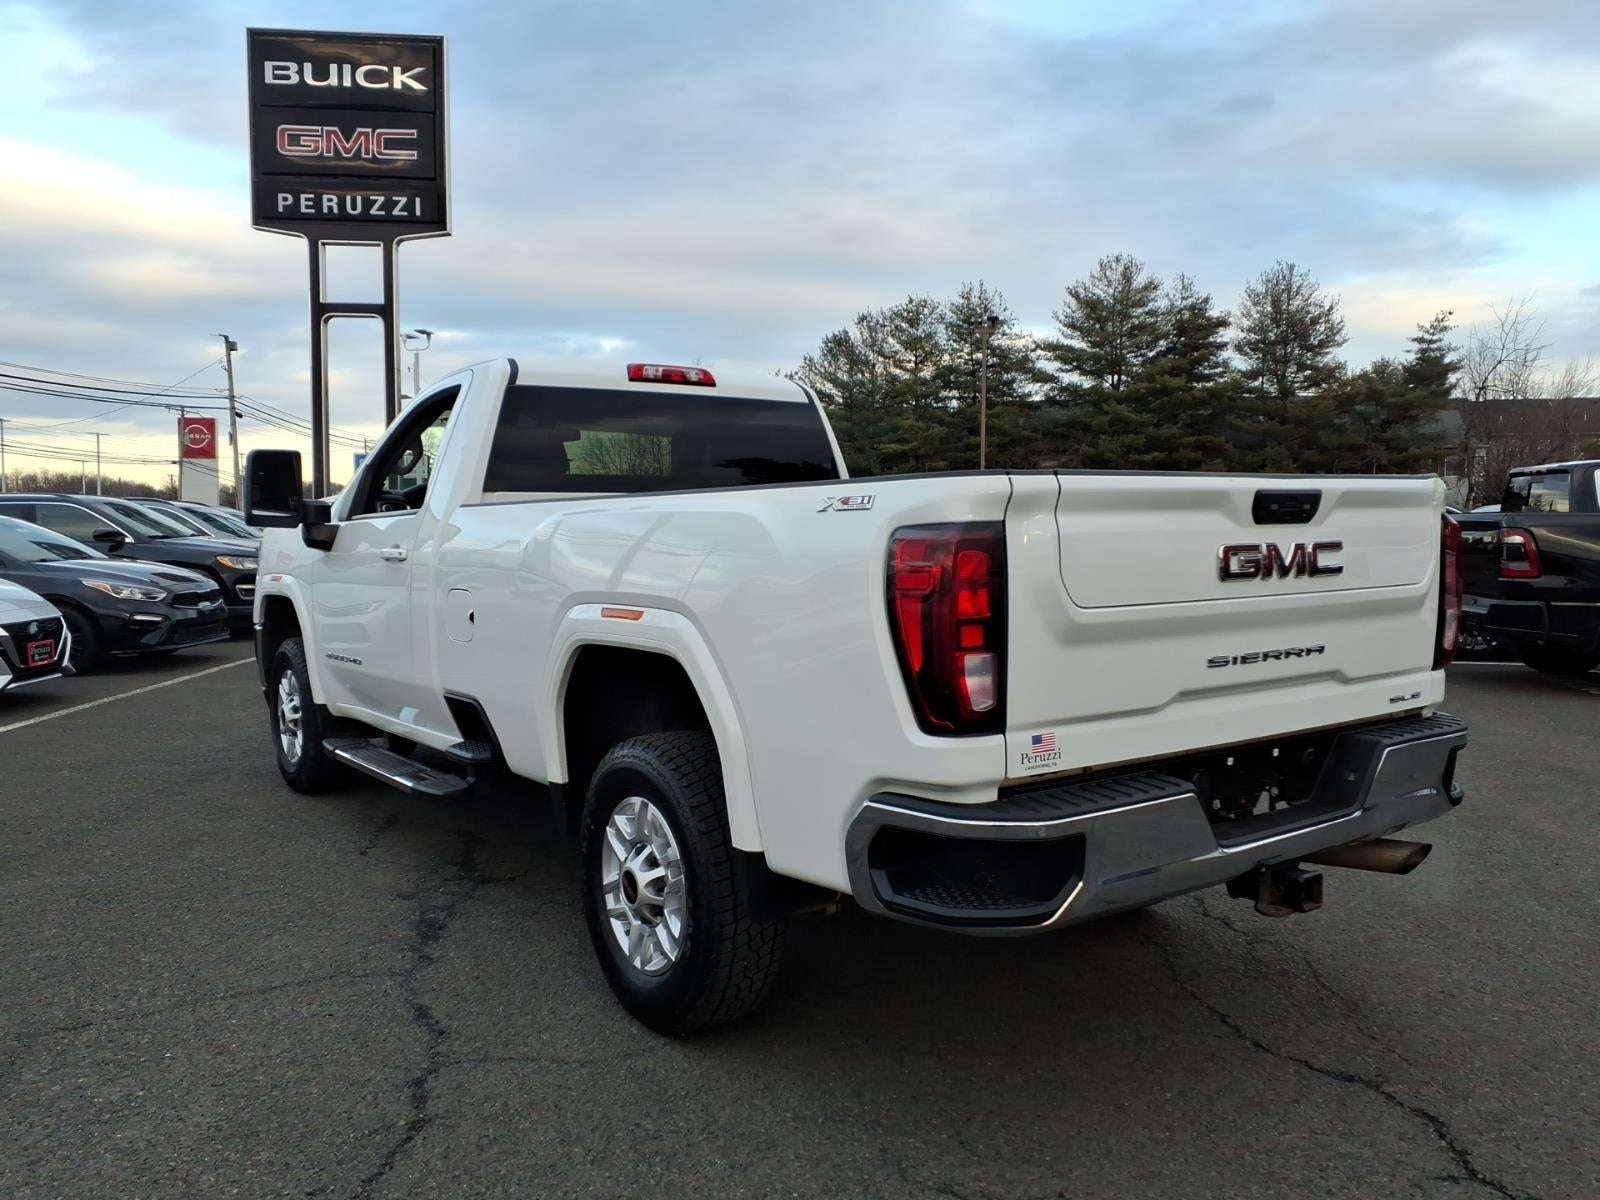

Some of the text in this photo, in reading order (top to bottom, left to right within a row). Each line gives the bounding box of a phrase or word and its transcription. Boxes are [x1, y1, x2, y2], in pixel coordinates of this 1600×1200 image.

[264, 61, 428, 90] BUICK
[277, 124, 418, 160] GMC
[277, 192, 421, 216] PERUZZI
[1216, 540, 1344, 582] GMC
[1206, 643, 1325, 668] SIERRA
[1020, 747, 1062, 765] Peruzzi
